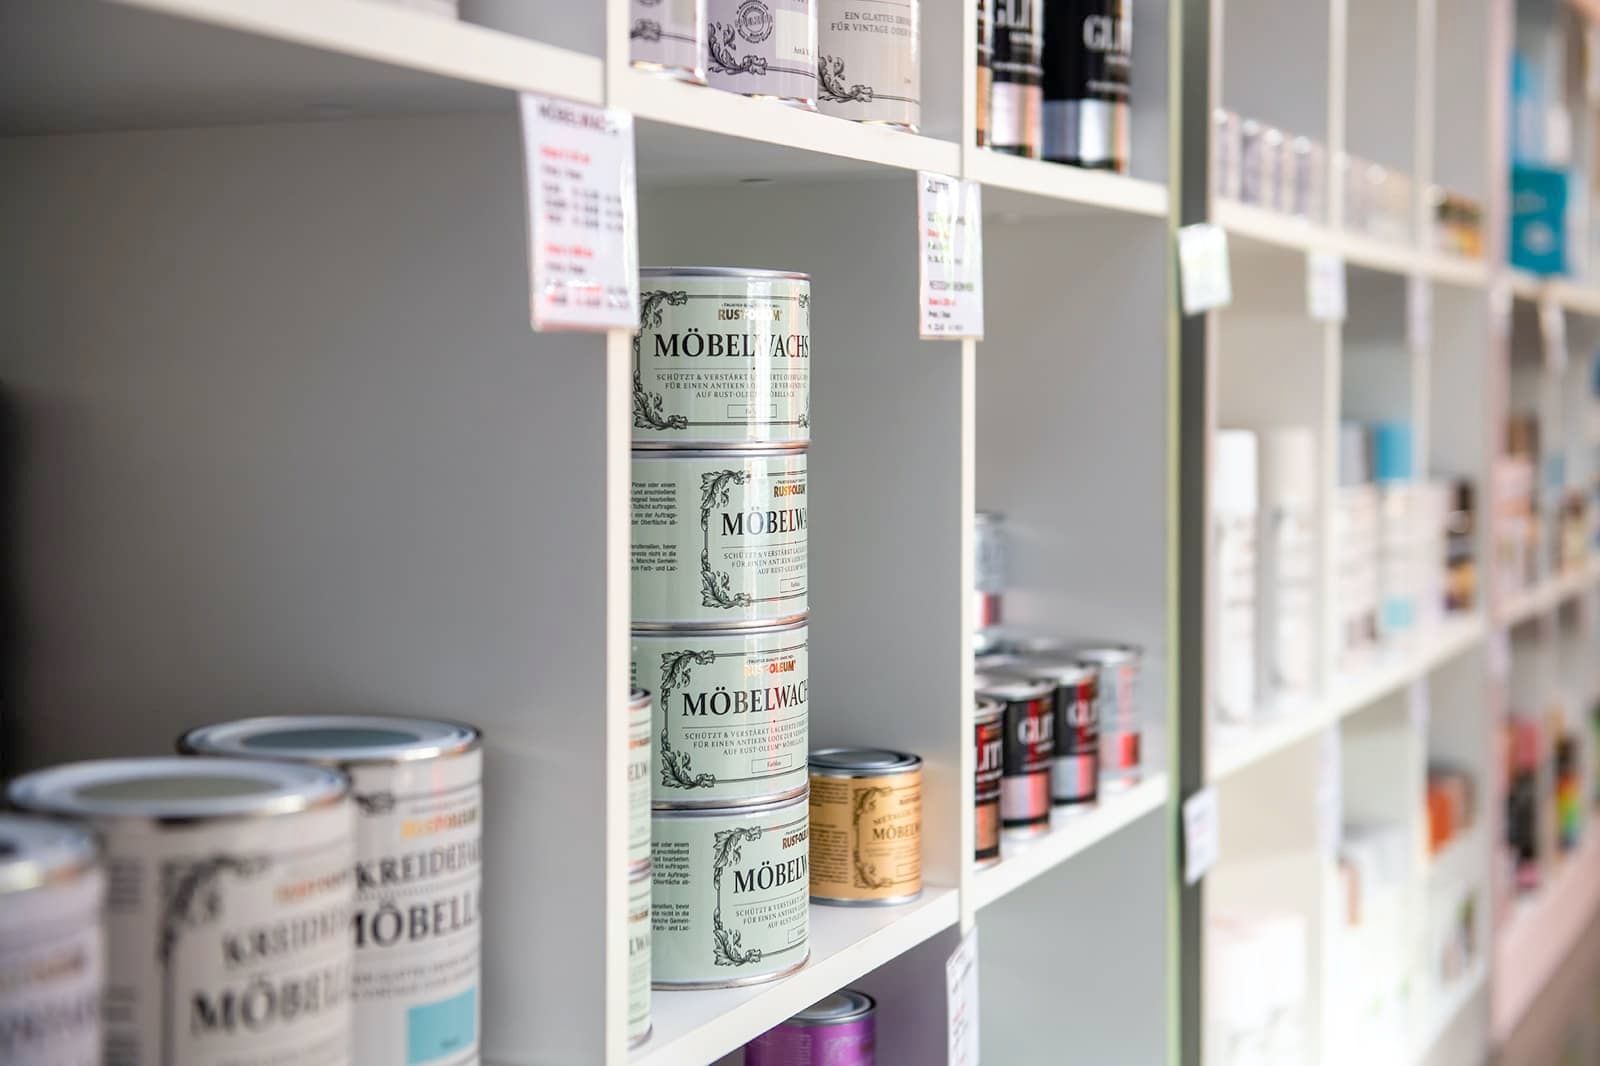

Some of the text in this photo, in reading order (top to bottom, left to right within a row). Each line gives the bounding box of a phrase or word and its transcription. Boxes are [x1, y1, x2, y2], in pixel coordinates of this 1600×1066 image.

[844, 11, 860, 21] EIN
[830, 21, 849, 32] FÜR
[852, 23, 888, 34] VINTAGE
[656, 374, 694, 382] SCHÜTZT
[704, 373, 748, 381] VERSTÄRKT
[665, 382, 681, 390] FÜR
[684, 732, 721, 741] SCHÜTZT
[693, 740, 709, 749] FÜR
[711, 738, 735, 748] EINEN
[722, 747, 737, 756] AUF
